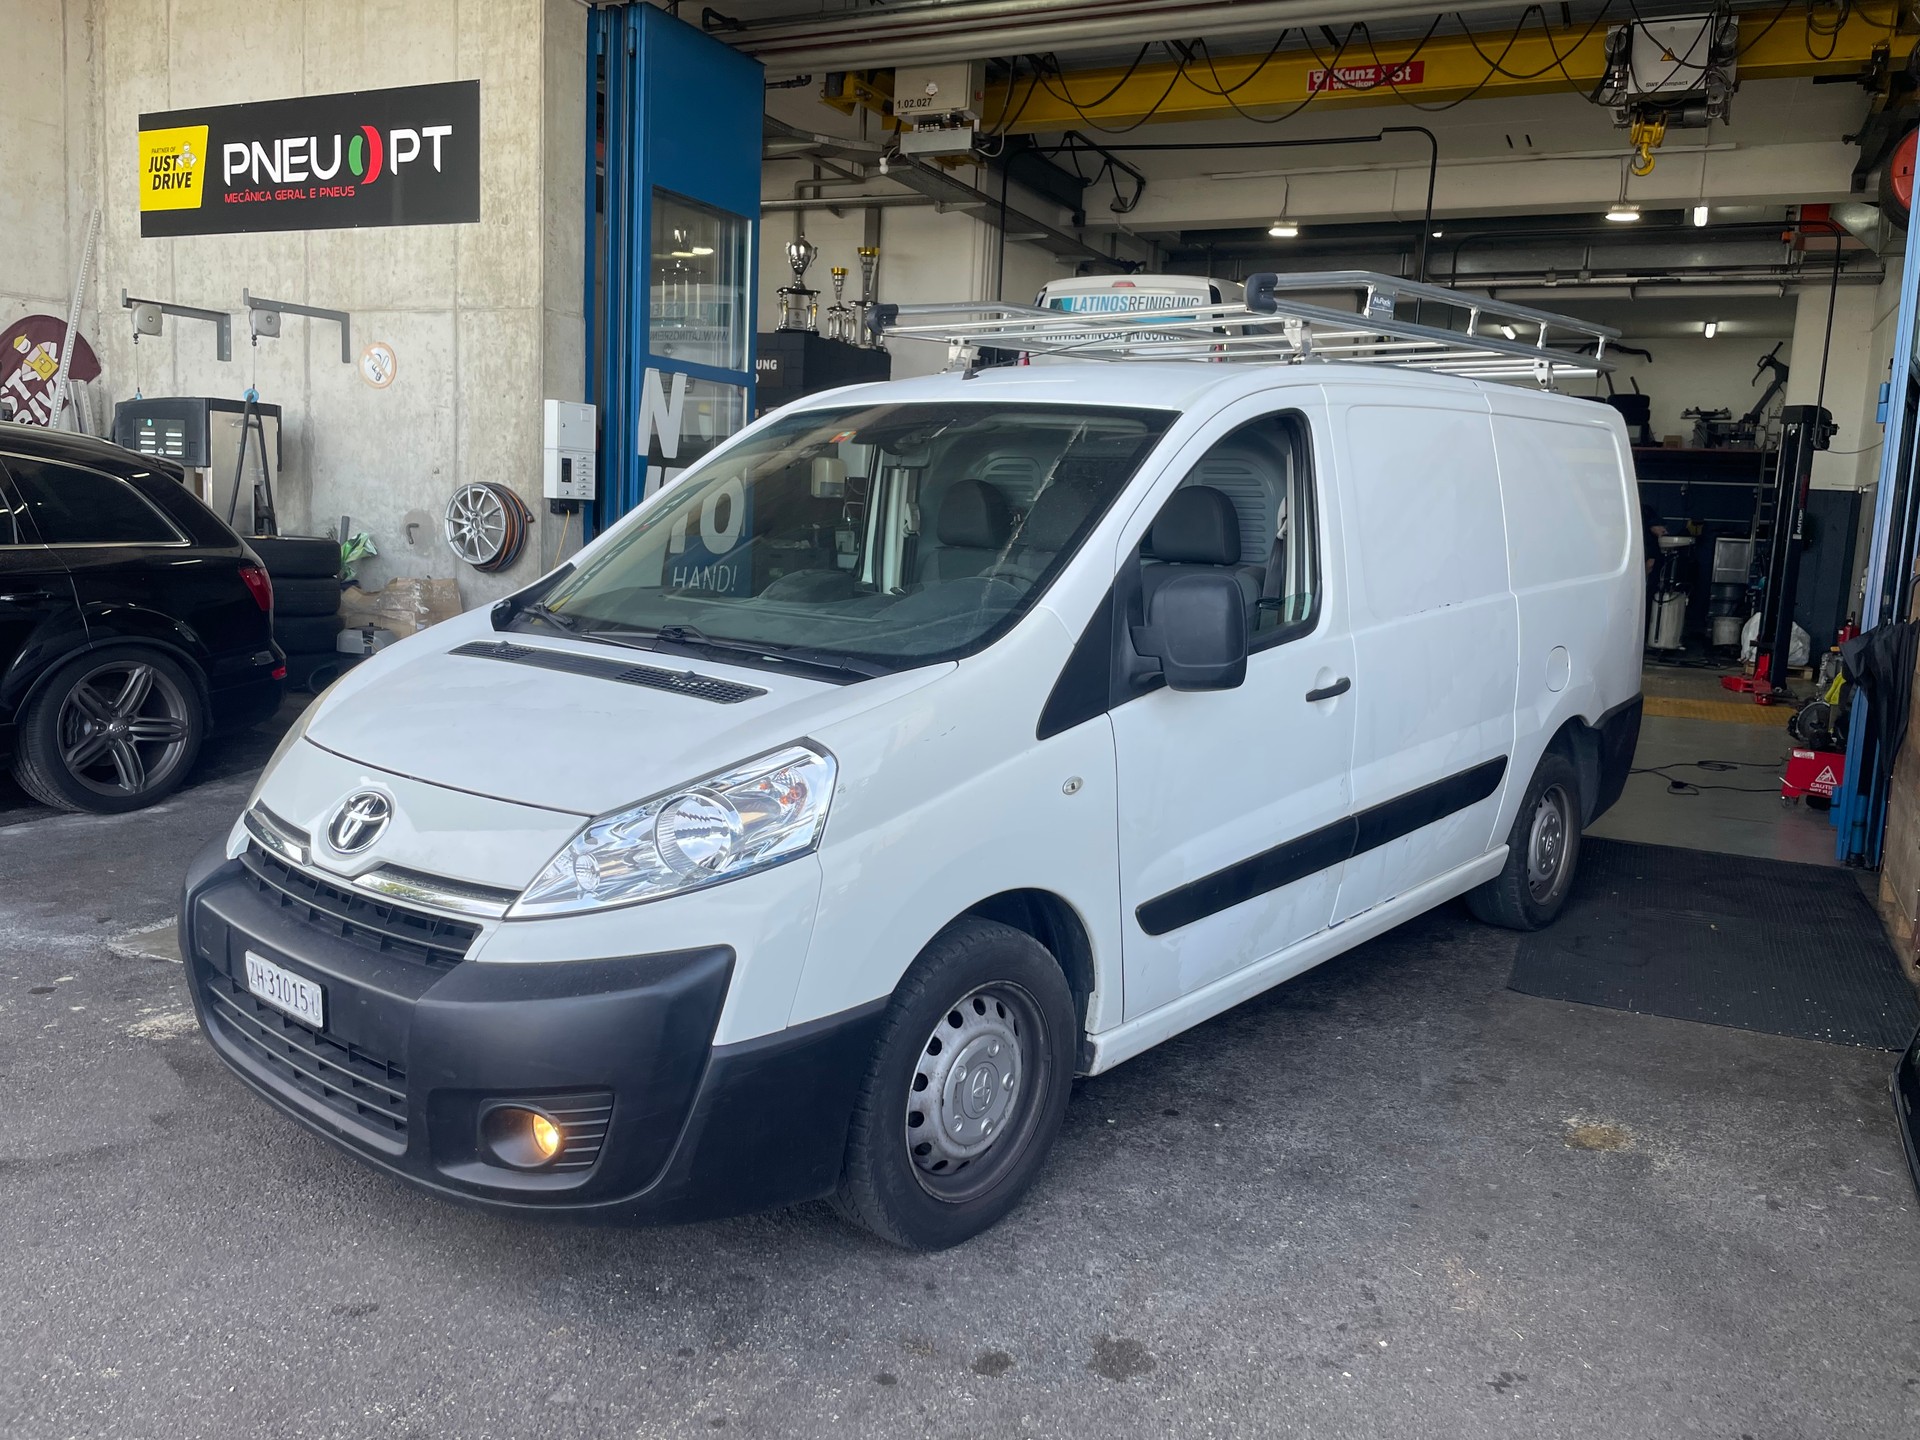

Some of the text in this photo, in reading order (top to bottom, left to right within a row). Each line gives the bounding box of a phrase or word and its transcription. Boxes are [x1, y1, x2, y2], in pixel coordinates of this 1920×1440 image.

[1333, 68, 1376, 82] Kunz
[897, 97, 932, 109] 1.02.027
[148, 154, 180, 173] JUST
[152, 171, 193, 190] DRIVE
[224, 185, 355, 203] MECÂNICA GERAL E PNEUS
[672, 565, 738, 592] HAND!
